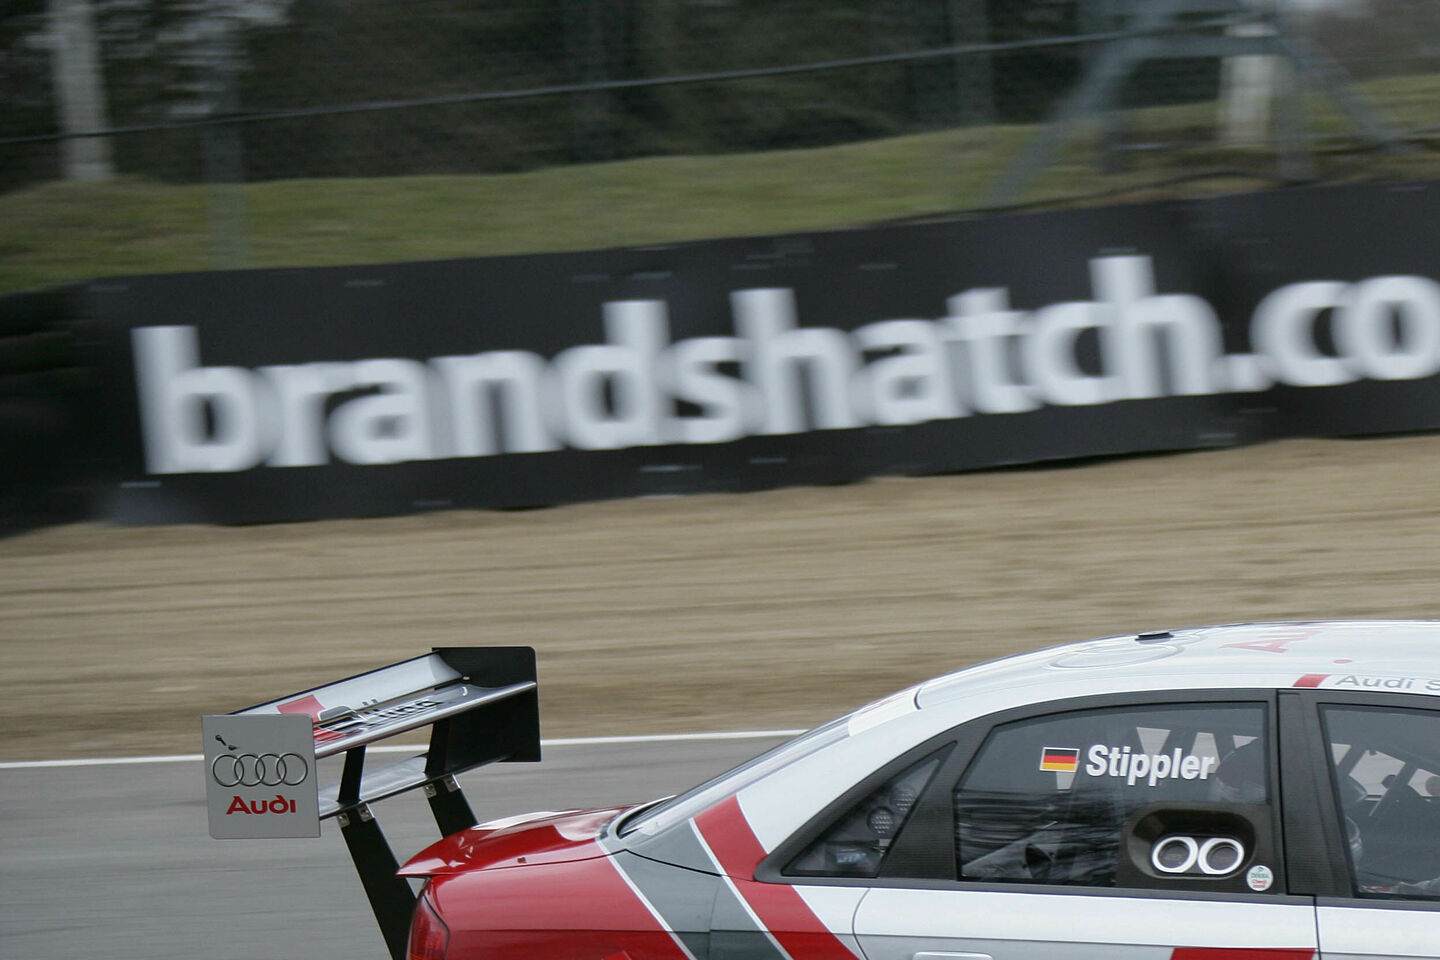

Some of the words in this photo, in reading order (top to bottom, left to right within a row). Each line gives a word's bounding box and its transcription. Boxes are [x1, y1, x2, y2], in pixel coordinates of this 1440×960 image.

[1336, 674, 1414, 690] Audi
[1086, 744, 1215, 787] Stippler
[226, 794, 296, 815] Audi
